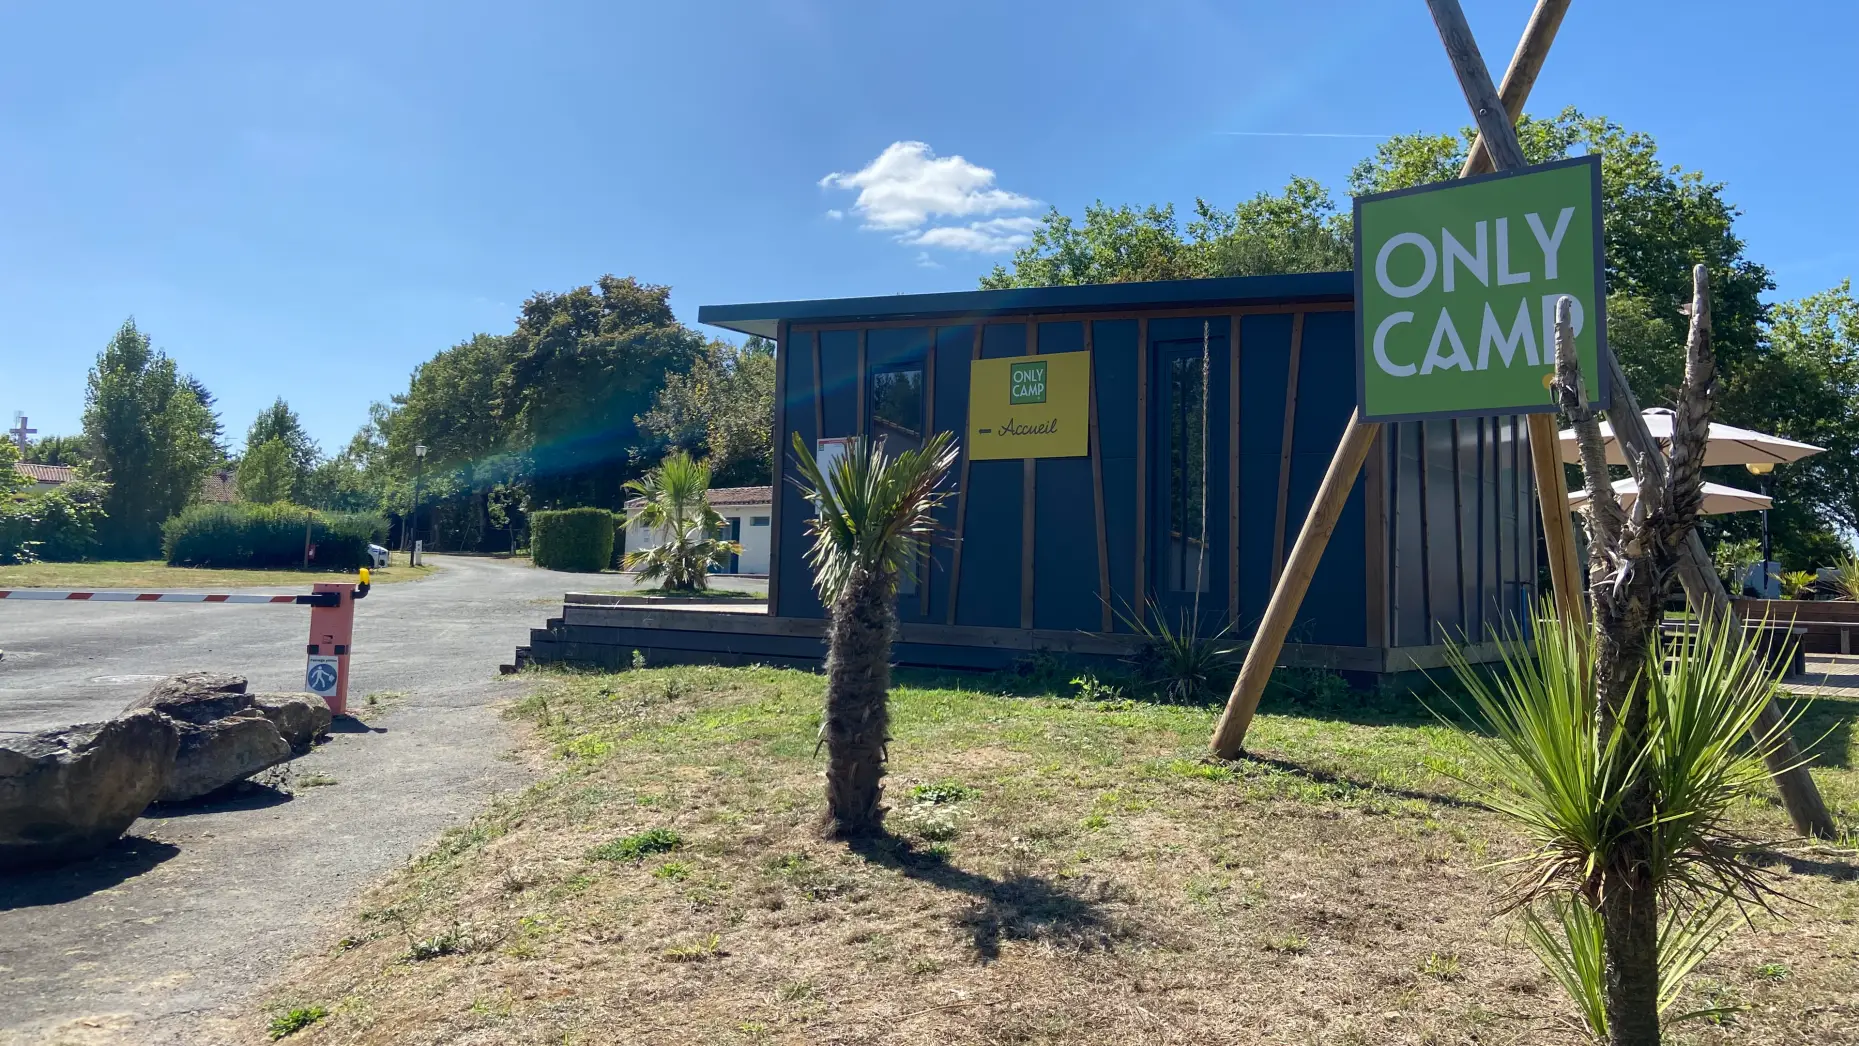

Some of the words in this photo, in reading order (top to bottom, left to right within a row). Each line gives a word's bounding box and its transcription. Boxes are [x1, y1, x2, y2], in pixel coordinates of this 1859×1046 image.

[1375, 206, 1576, 299] ONLY
[1372, 293, 1585, 378] CAMP
[1013, 368, 1044, 383] ONLY
[1012, 383, 1044, 397] CAMP
[998, 417, 1058, 437] Accueil
